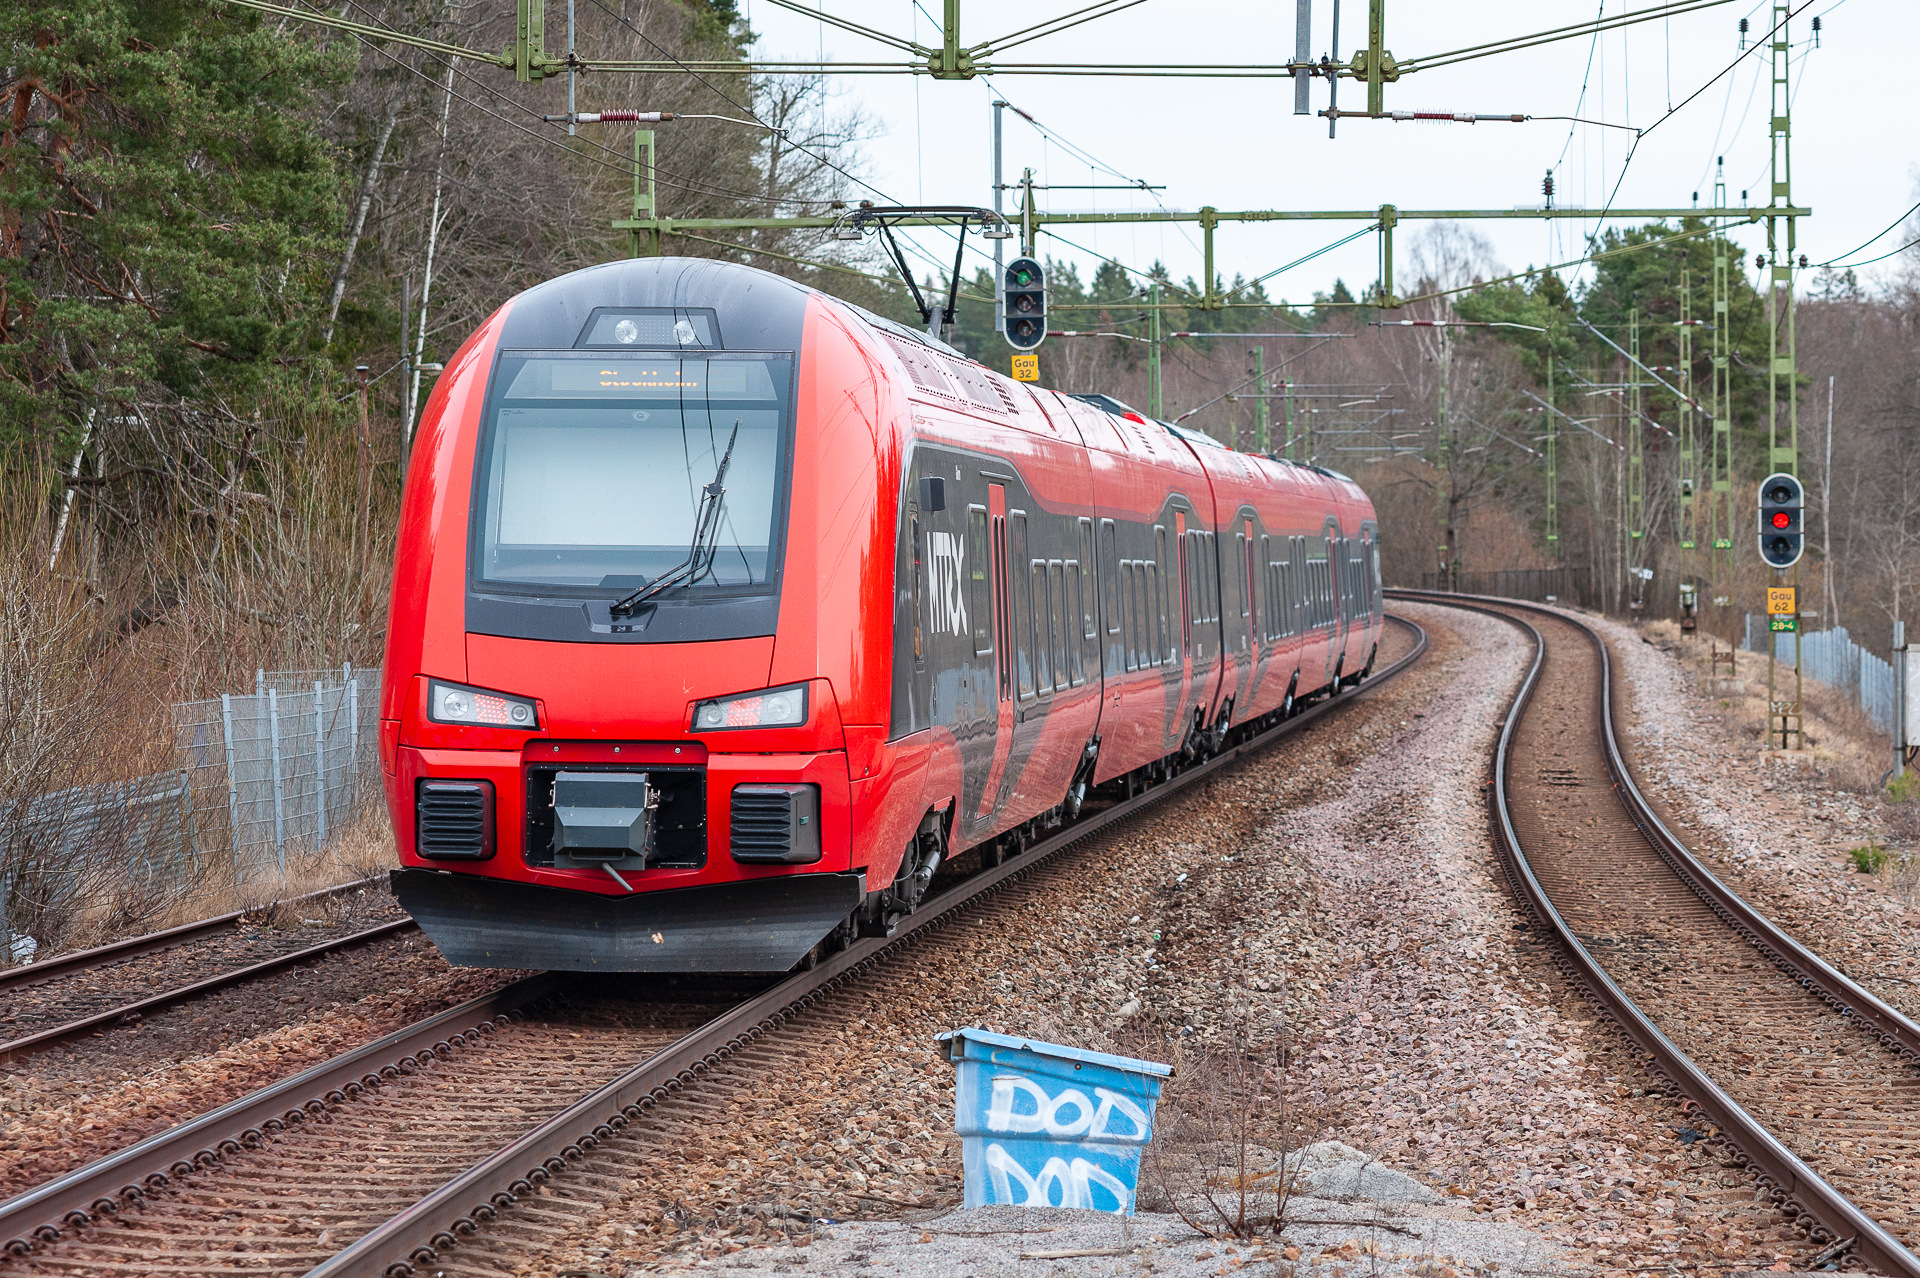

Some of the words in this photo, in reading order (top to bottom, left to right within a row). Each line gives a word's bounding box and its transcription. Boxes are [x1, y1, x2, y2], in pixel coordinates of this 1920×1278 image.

[1014, 358, 1035, 368] Gau
[1018, 369, 1032, 379] 32
[1770, 591, 1792, 601] Gau
[1774, 602, 1789, 612] 62
[1772, 621, 1794, 630] 28-4
